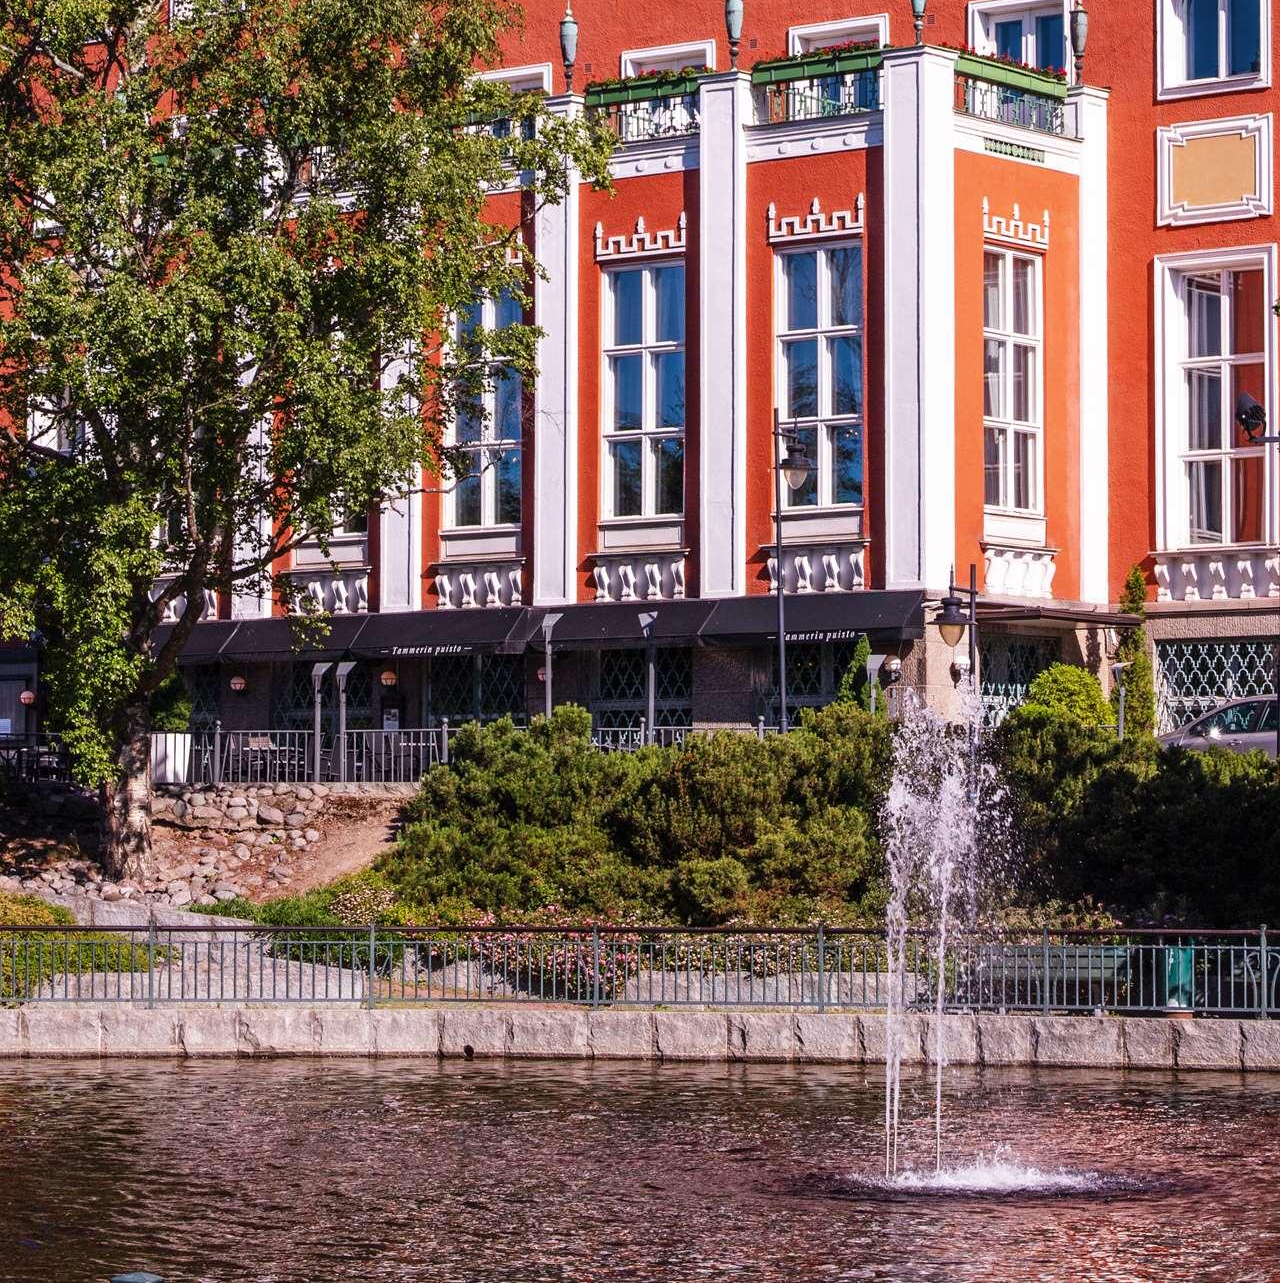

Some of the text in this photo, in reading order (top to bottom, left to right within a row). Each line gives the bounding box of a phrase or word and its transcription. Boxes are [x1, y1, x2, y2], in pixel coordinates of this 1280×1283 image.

[783, 629, 855, 642] ammerin puisto
[392, 644, 462, 656] Tammerin puisto
